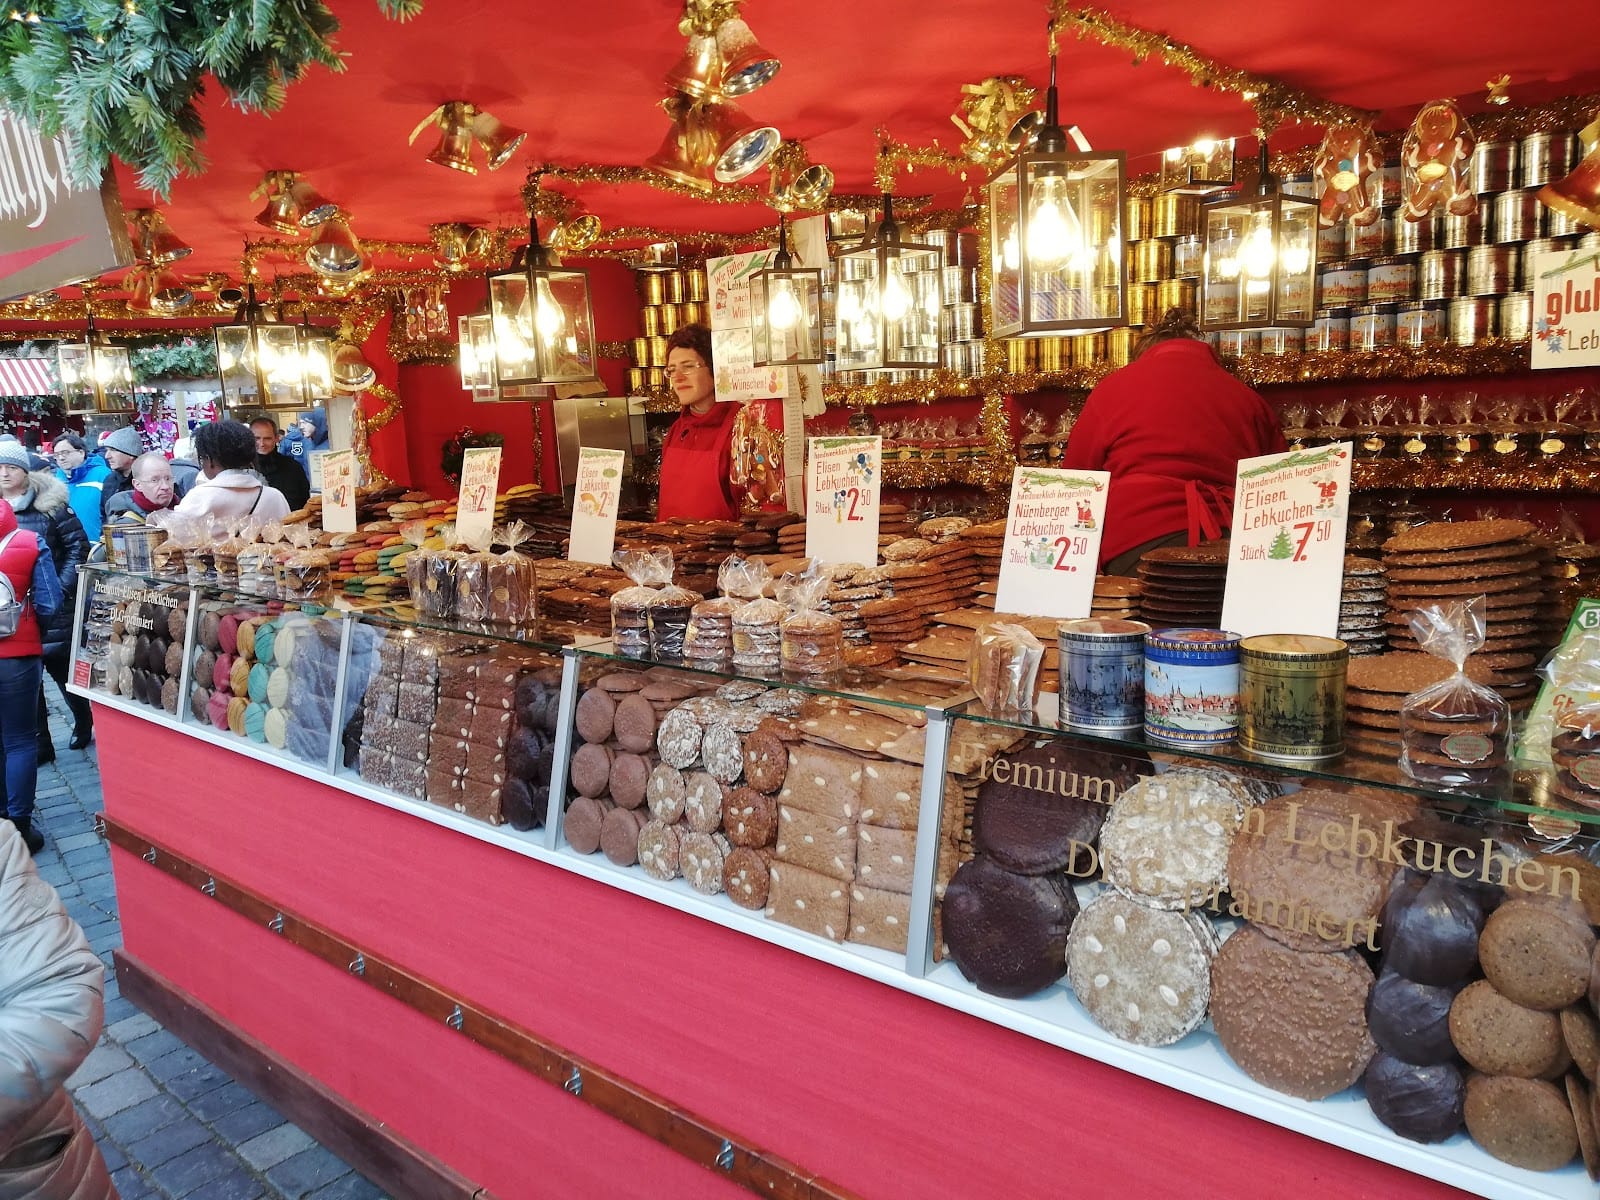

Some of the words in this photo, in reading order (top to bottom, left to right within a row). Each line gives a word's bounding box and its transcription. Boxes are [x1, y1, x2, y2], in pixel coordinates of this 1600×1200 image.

[291, 442, 304, 456] 5
[816, 461, 840, 475] Elisen
[816, 474, 859, 491] Lebkuchen
[1245, 490, 1287, 510] Elisen
[1015, 503, 1070, 520] Nürnberger
[1243, 501, 1314, 531] Lebkuchen
[1012, 520, 1065, 536] Lebkuchen
[1010, 549, 1028, 565] Stück
[1240, 545, 1267, 561] Stück
[143, 589, 179, 609] Lebkuchen
[1282, 801, 1583, 901] Lebkuchen
